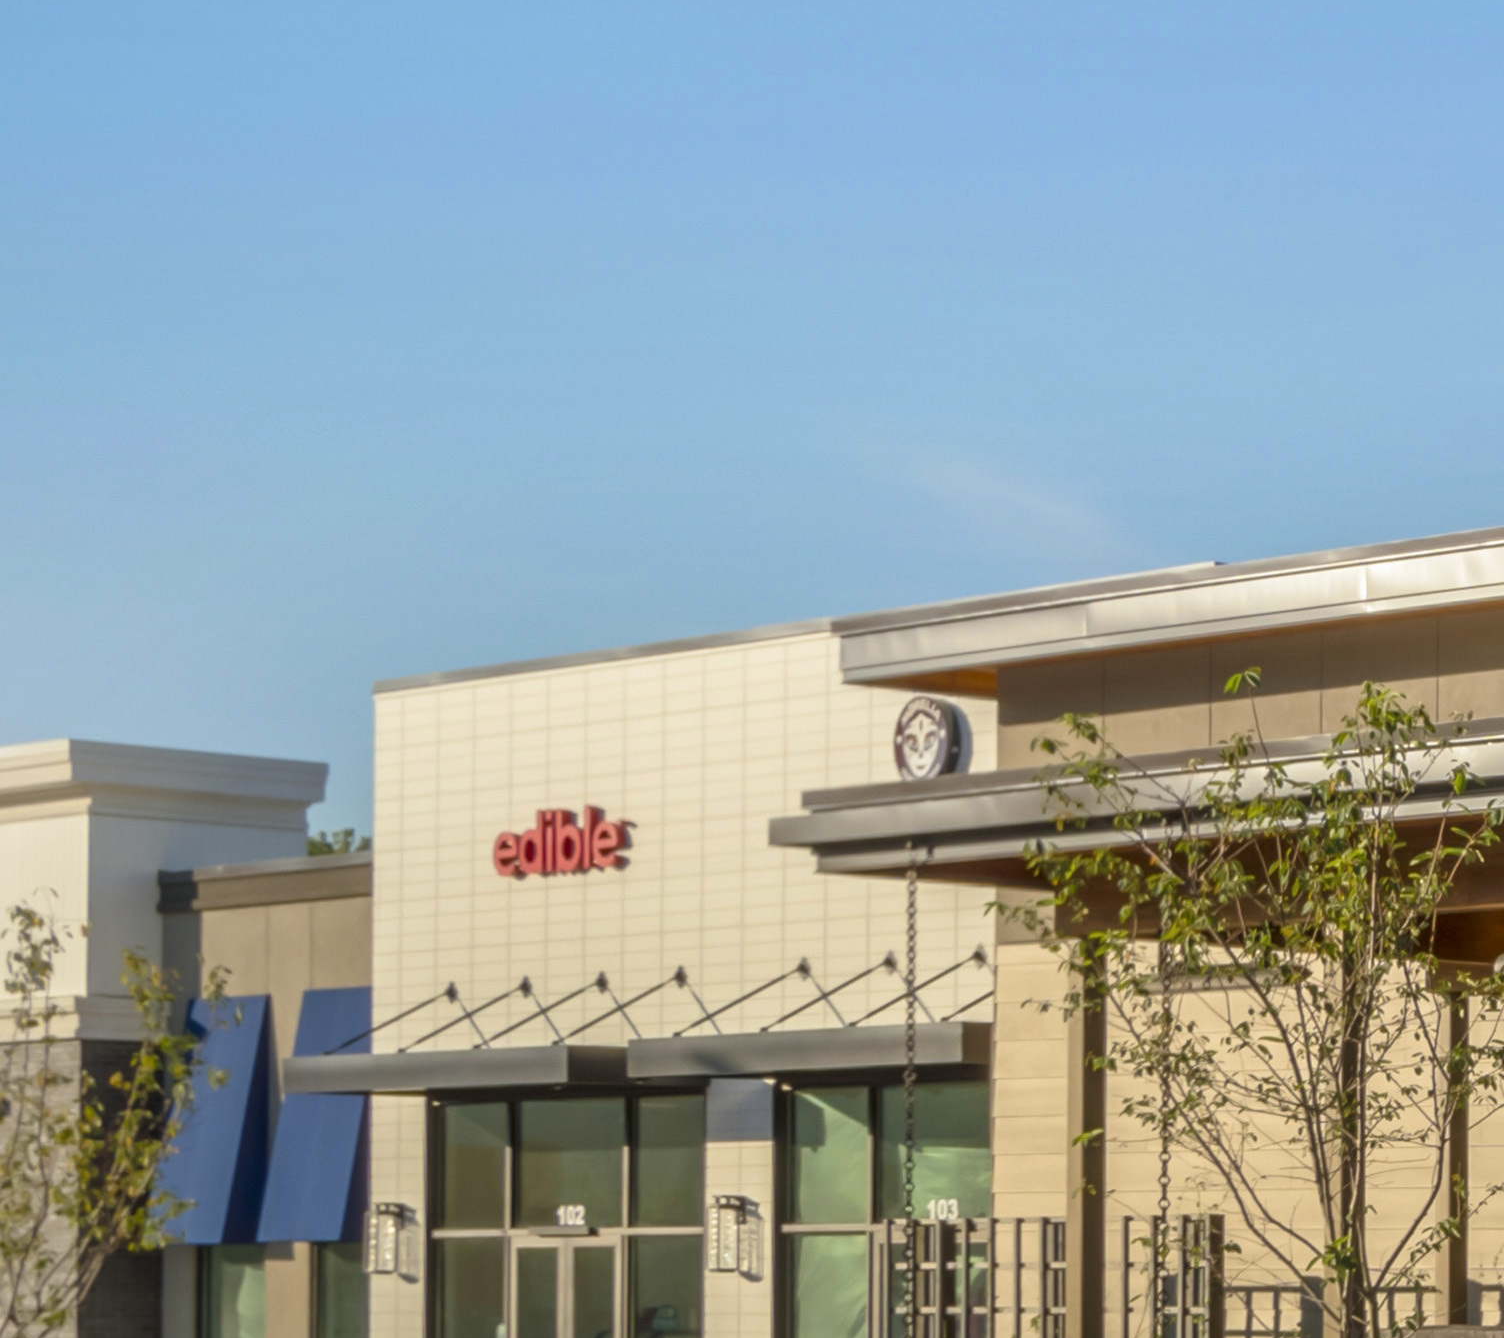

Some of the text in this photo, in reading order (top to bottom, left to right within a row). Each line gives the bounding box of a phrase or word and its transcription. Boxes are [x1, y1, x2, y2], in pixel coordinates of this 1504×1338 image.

[493, 804, 620, 877] edible
[556, 1204, 585, 1226] 102
[926, 1198, 958, 1221] 103
